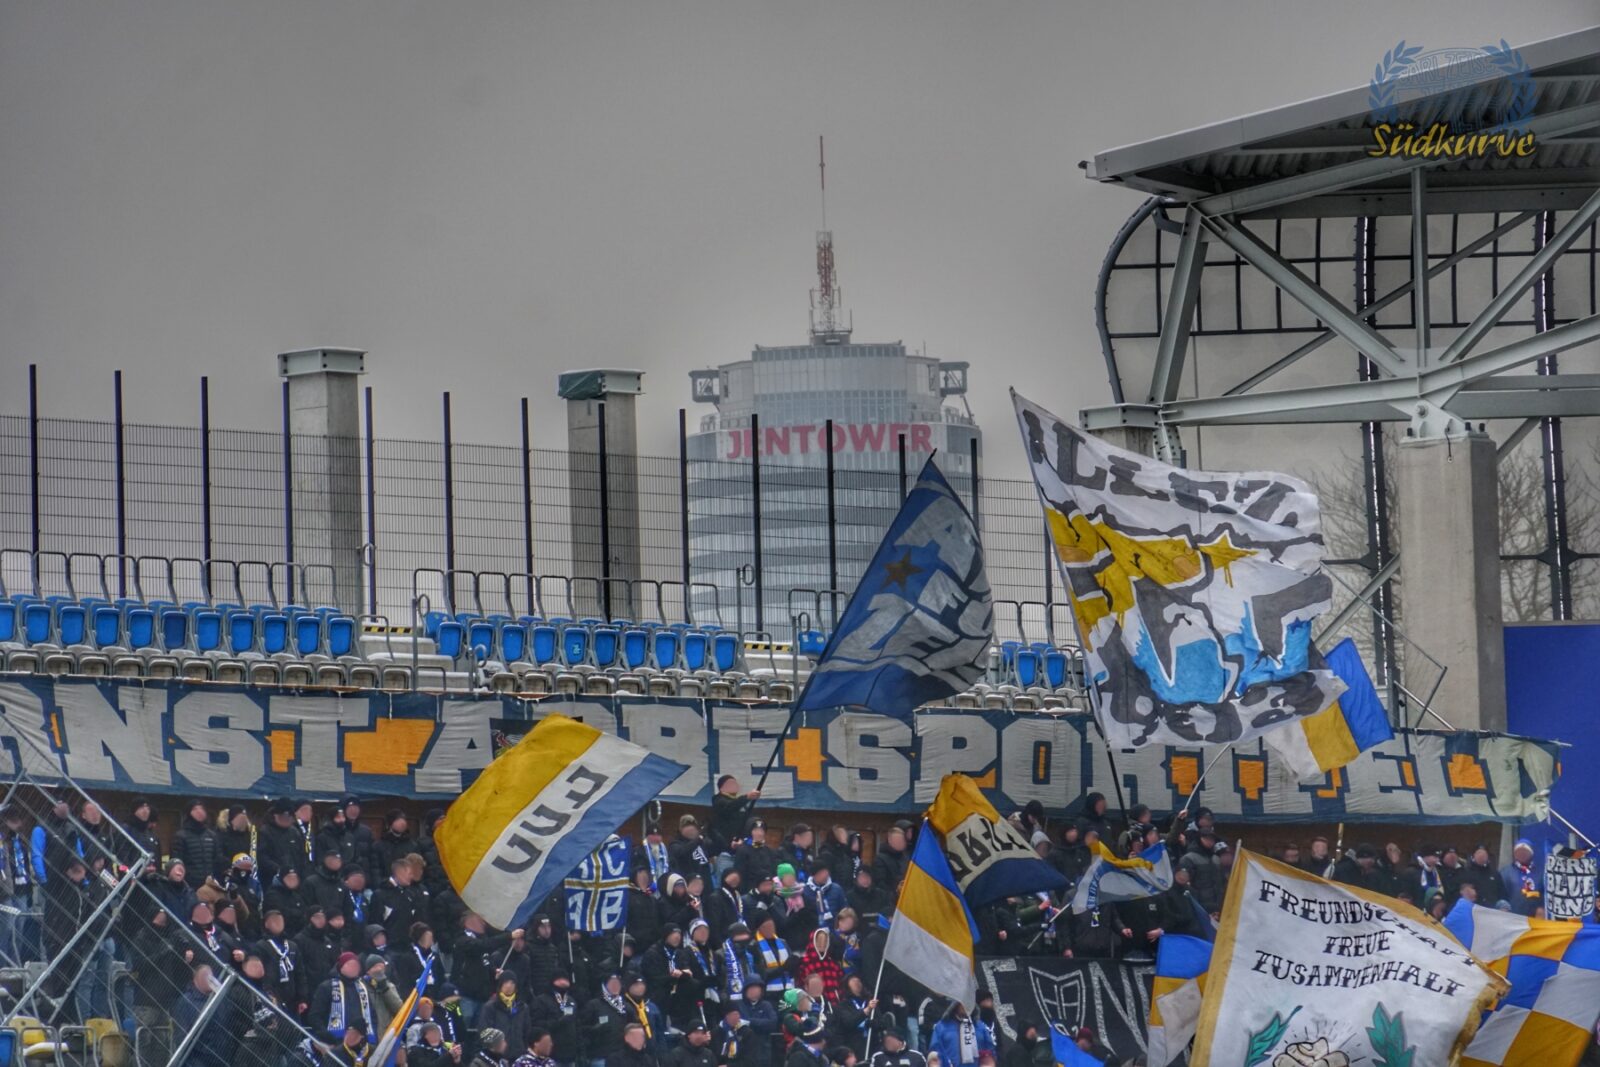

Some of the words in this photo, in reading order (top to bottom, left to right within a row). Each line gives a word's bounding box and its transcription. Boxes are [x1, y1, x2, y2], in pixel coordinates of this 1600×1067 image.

[726, 422, 935, 459] JENTOWER
[414, 699, 795, 800] ABE
[1546, 854, 1597, 875] DARK
[1546, 872, 1594, 898] BLUE
[1322, 930, 1395, 957] TREUE
[1251, 950, 1465, 997] ZUSAMMENHALT
